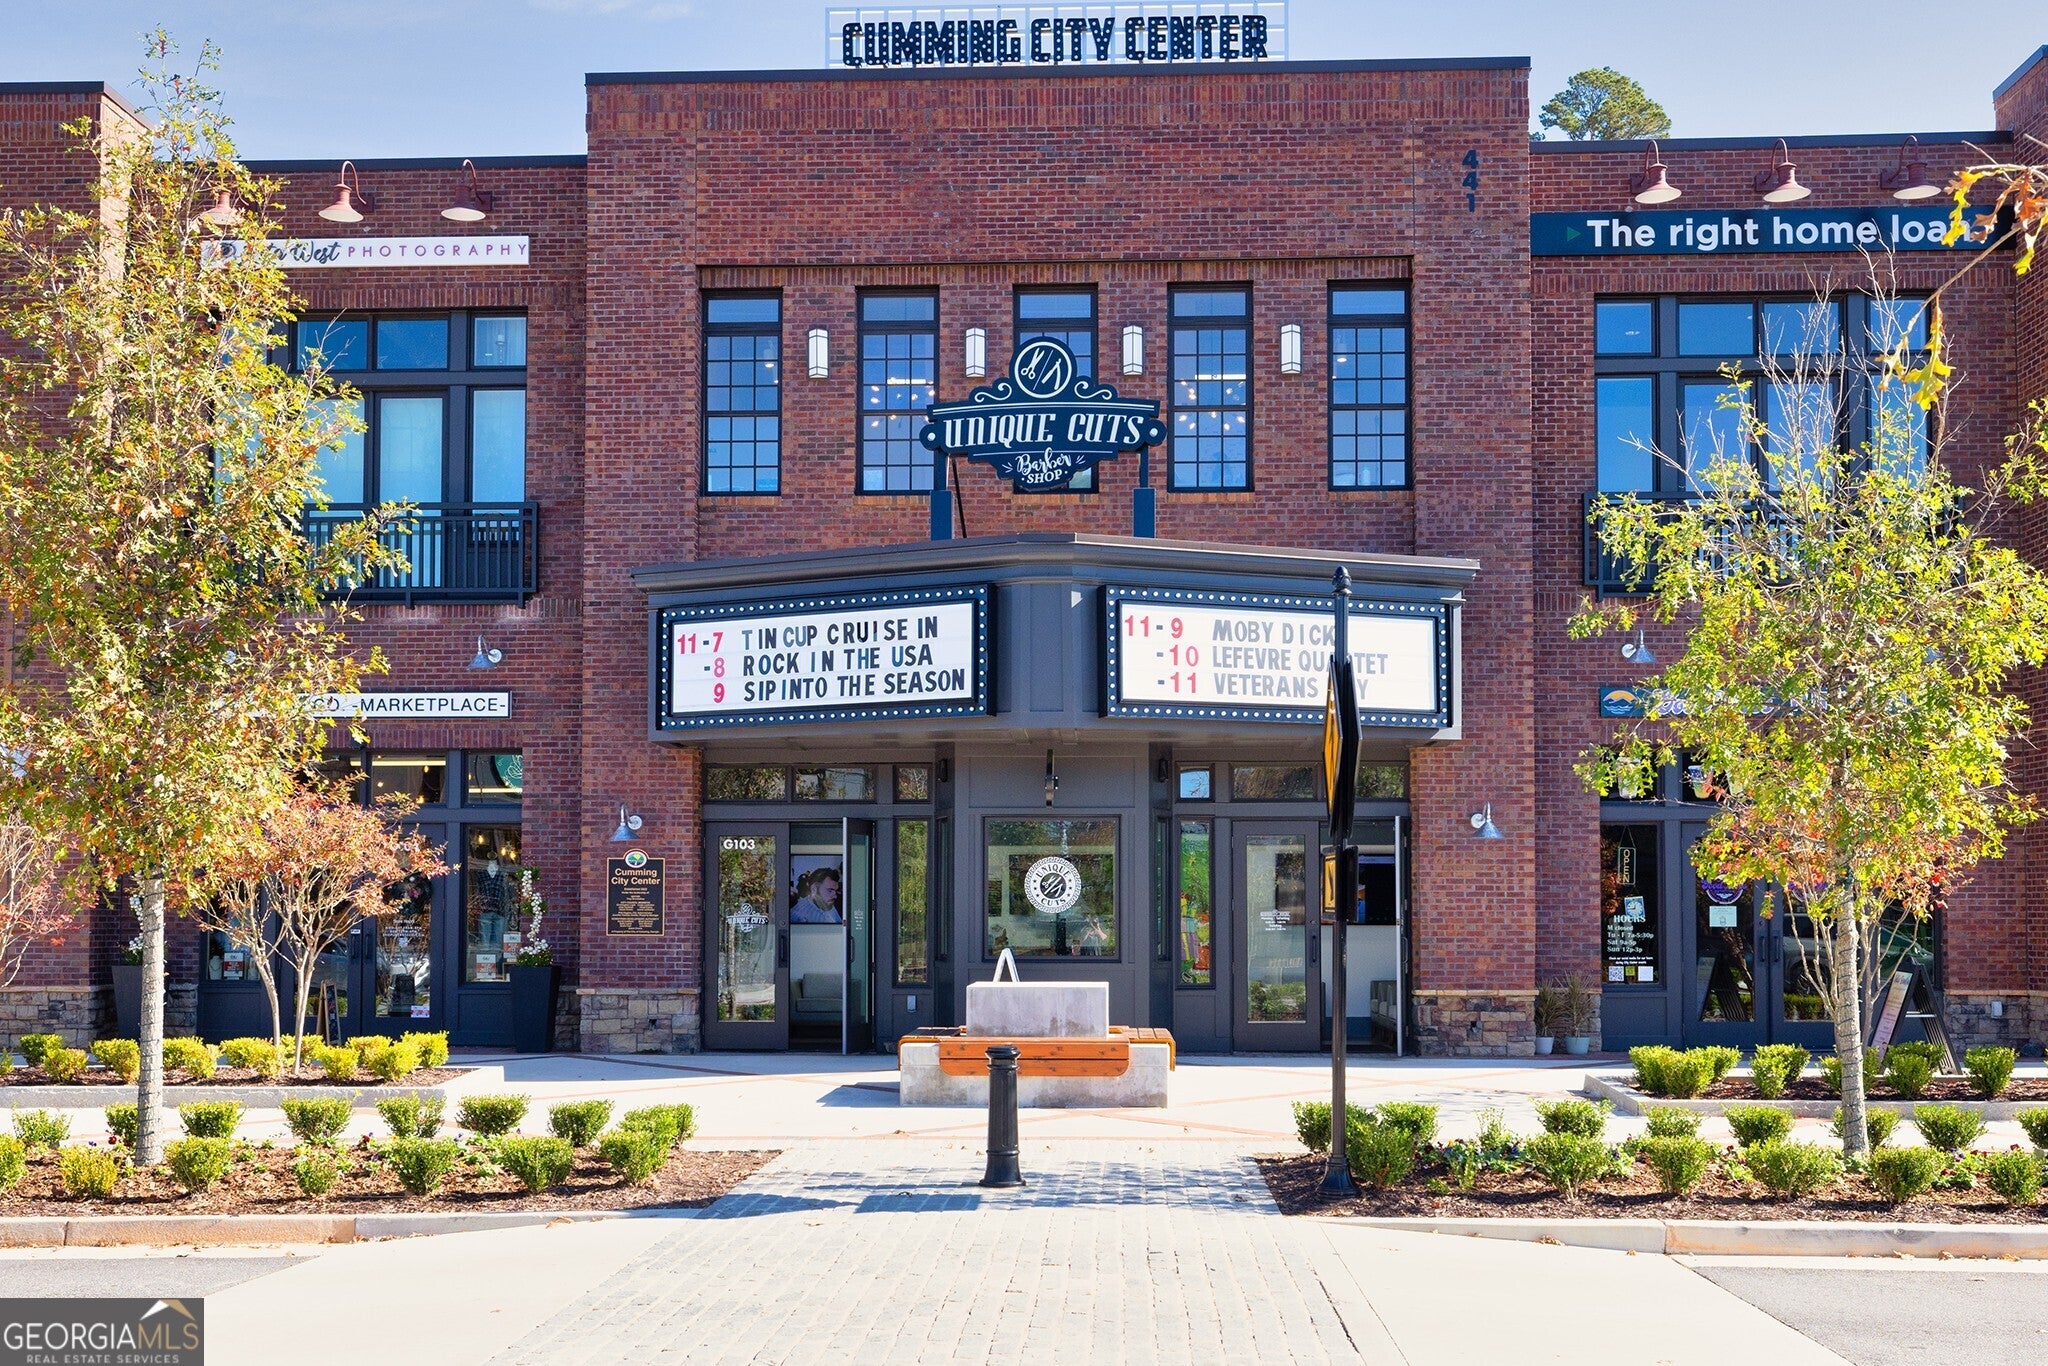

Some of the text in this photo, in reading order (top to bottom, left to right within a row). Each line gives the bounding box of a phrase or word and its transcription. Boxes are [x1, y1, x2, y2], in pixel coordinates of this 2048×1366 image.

[842, 14, 1269, 67] CUMMING CITY CENTER
[1462, 149, 1479, 213] 441
[1586, 218, 1656, 247] The
[1669, 216, 1760, 252] right
[1773, 215, 1878, 246] home
[348, 243, 527, 258] PHOTOGRAPHY
[943, 412, 1144, 449] UNIQUE CUTS
[1014, 446, 1072, 476] Barber
[1026, 470, 1062, 485] SHOP
[827, 618, 908, 645] CRUISE
[917, 615, 938, 640] IN
[1212, 619, 1276, 643] MOBY
[1282, 622, 1335, 647] DICK
[703, 643, 933, 678] -8 ROCK IN THE USA
[1156, 643, 1388, 675] -10 LEFEVRE QUTET
[713, 682, 725, 704] 9
[837, 673, 875, 697] THE
[883, 668, 965, 695] SEASON
[1157, 671, 1197, 694] -11
[1213, 673, 1319, 699] VETERANS
[723, 839, 756, 850] G103
[614, 868, 657, 878] Cumming
[1036, 863, 1071, 878] UNIQUE
[1623, 848, 1631, 884] OPEN
[611, 877, 660, 886] City Center
[1040, 898, 1066, 907] CUTS
[1613, 914, 1646, 923] HOURS
